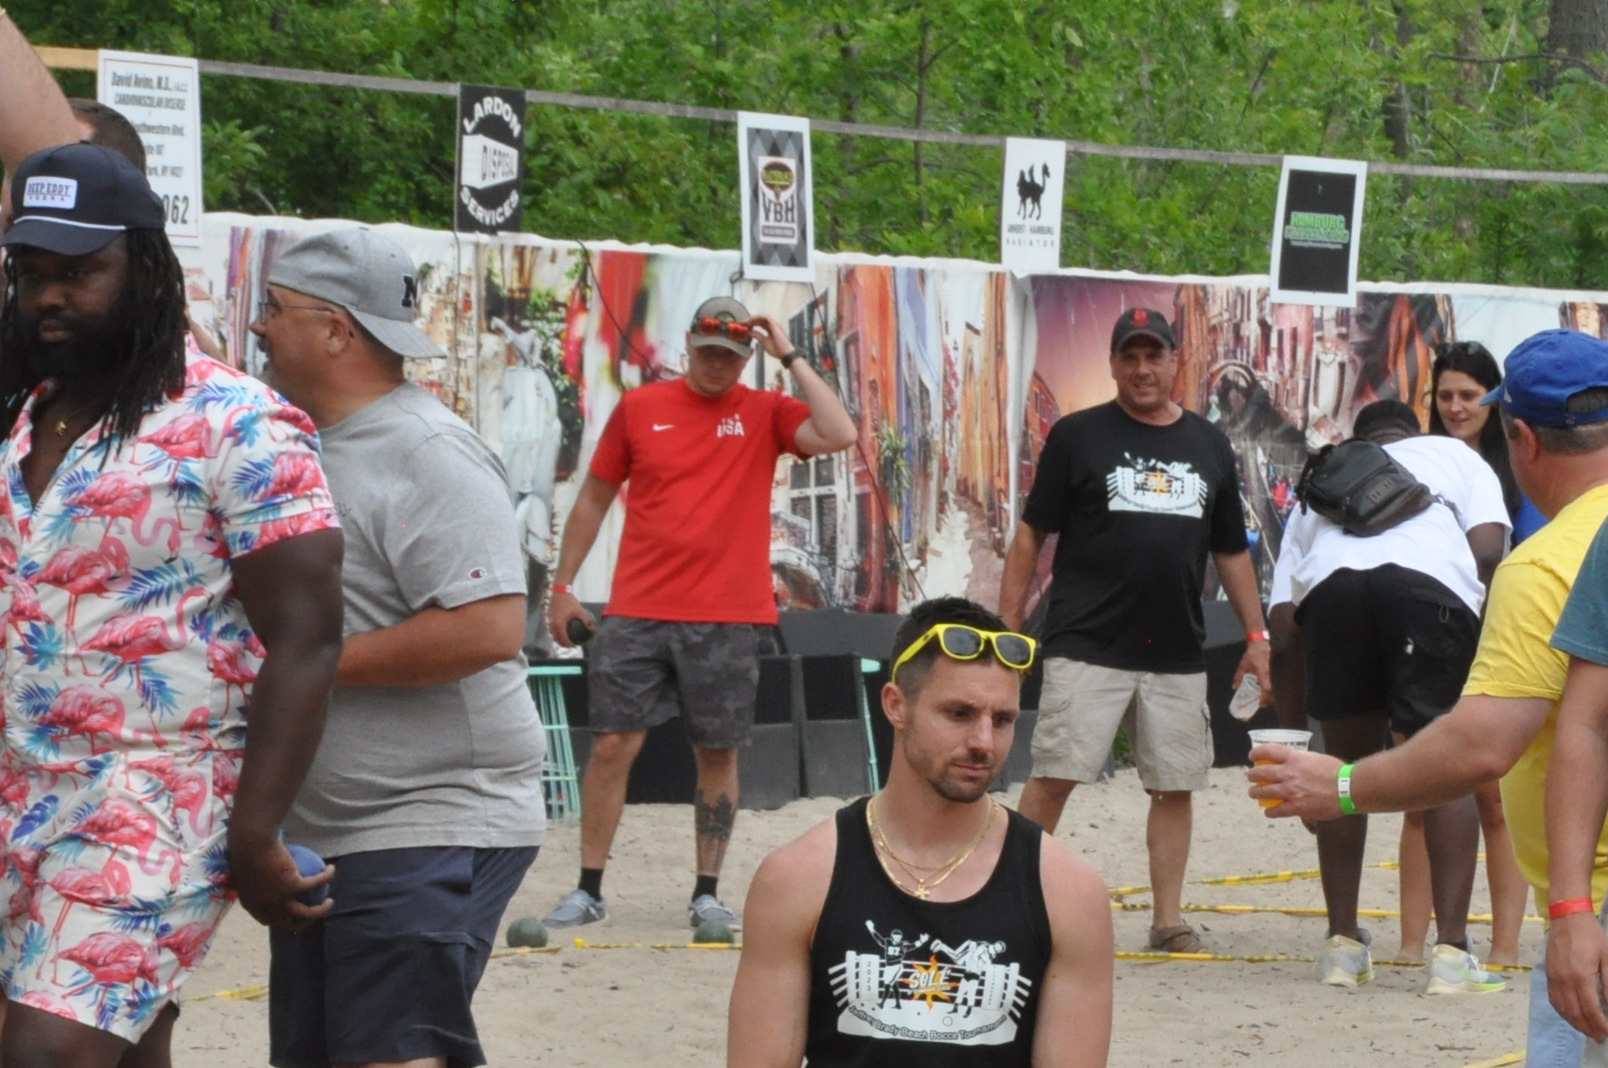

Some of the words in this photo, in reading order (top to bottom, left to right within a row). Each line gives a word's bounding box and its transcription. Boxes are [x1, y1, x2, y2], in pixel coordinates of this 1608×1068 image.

[131, 121, 171, 136] outhwestern
[463, 96, 522, 139] LARDON
[46, 183, 71, 195] EDDY
[459, 189, 521, 227] SERVICES
[716, 421, 745, 438] USA
[908, 967, 952, 989] SOLE
[900, 1026, 928, 1040] Beach
[929, 1029, 958, 1041] Bocce
[958, 1013, 1008, 1041] Tournament
